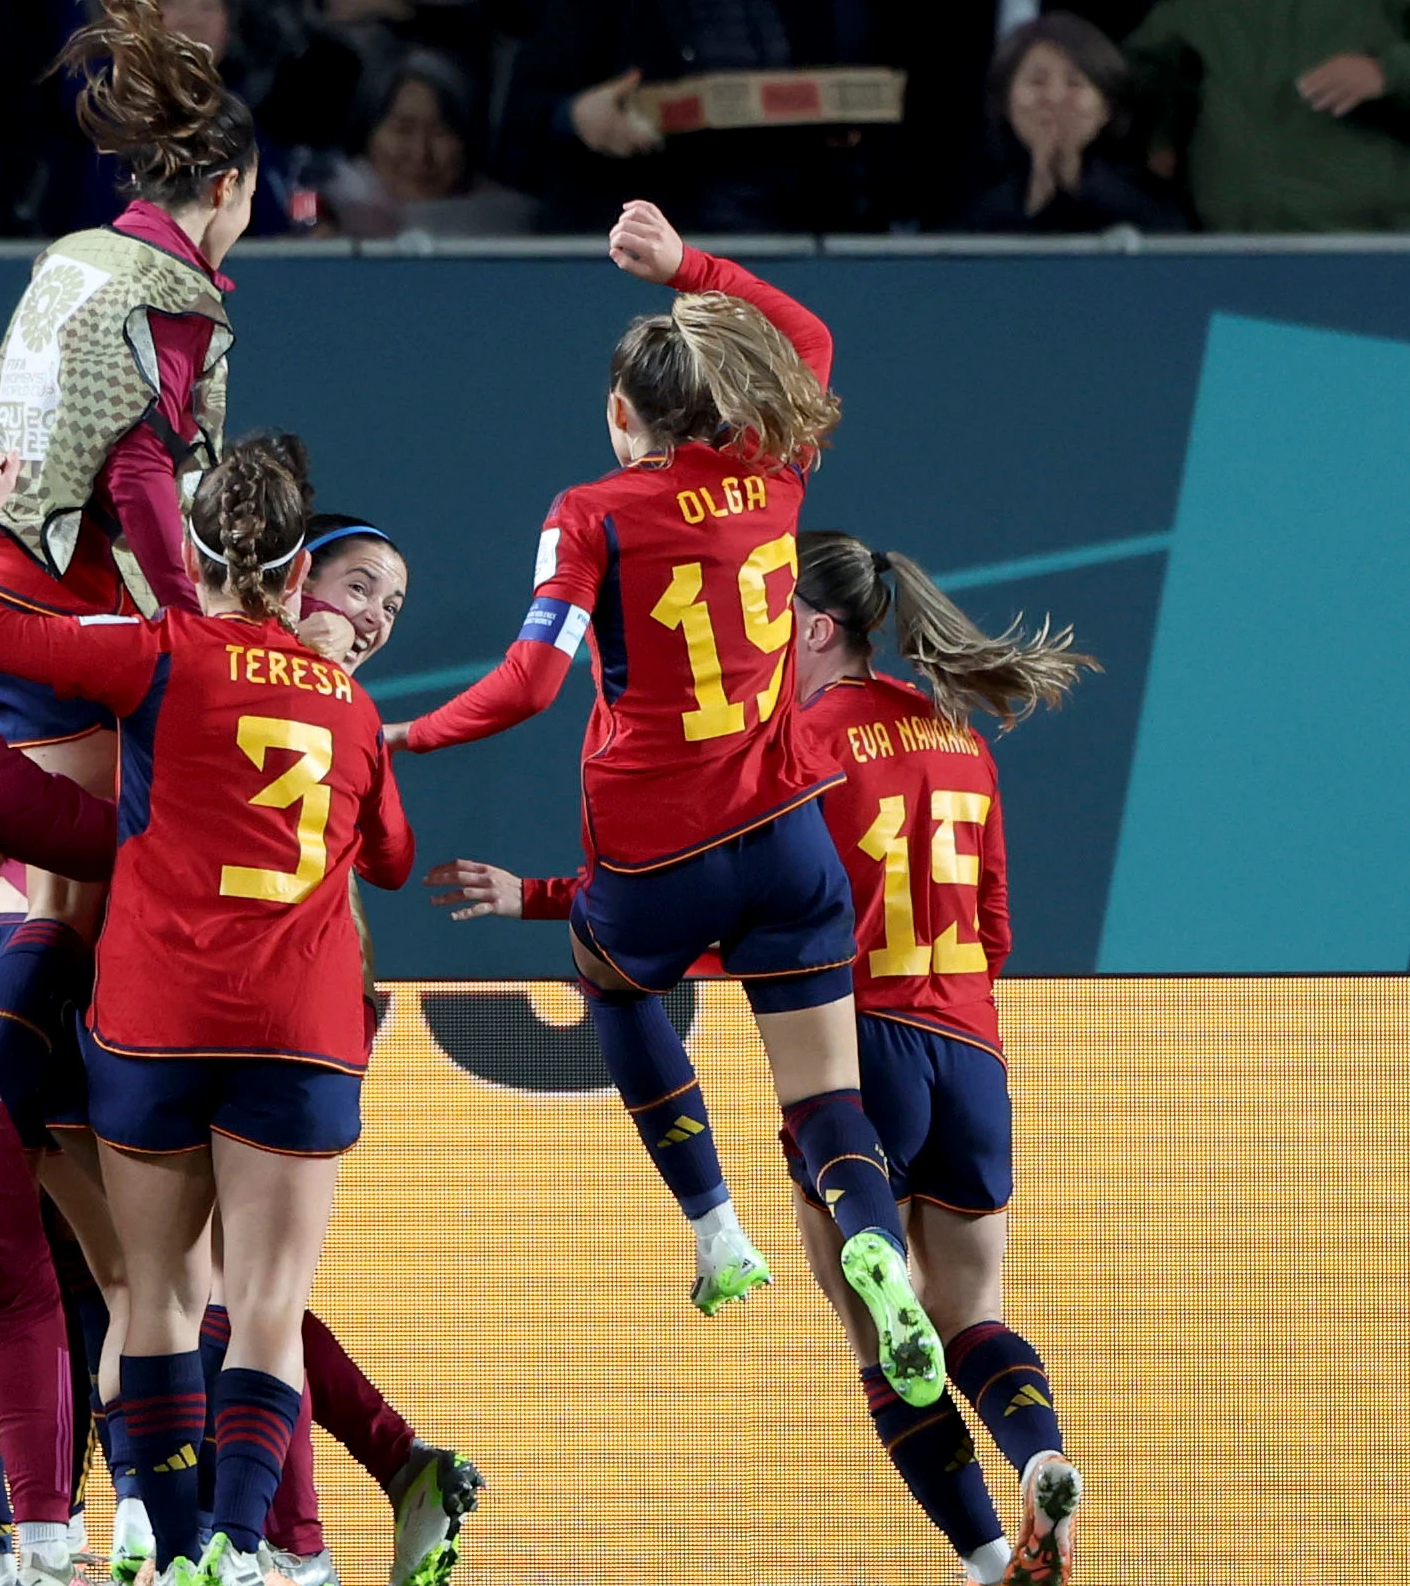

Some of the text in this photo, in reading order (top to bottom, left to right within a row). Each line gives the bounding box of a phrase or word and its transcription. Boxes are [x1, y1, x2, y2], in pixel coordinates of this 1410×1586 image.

[676, 475, 768, 525] OLGA
[225, 644, 353, 703] TERESA
[649, 532, 799, 743] 19
[846, 721, 895, 763] EVA
[218, 714, 333, 904] 3
[856, 789, 991, 980] 15
